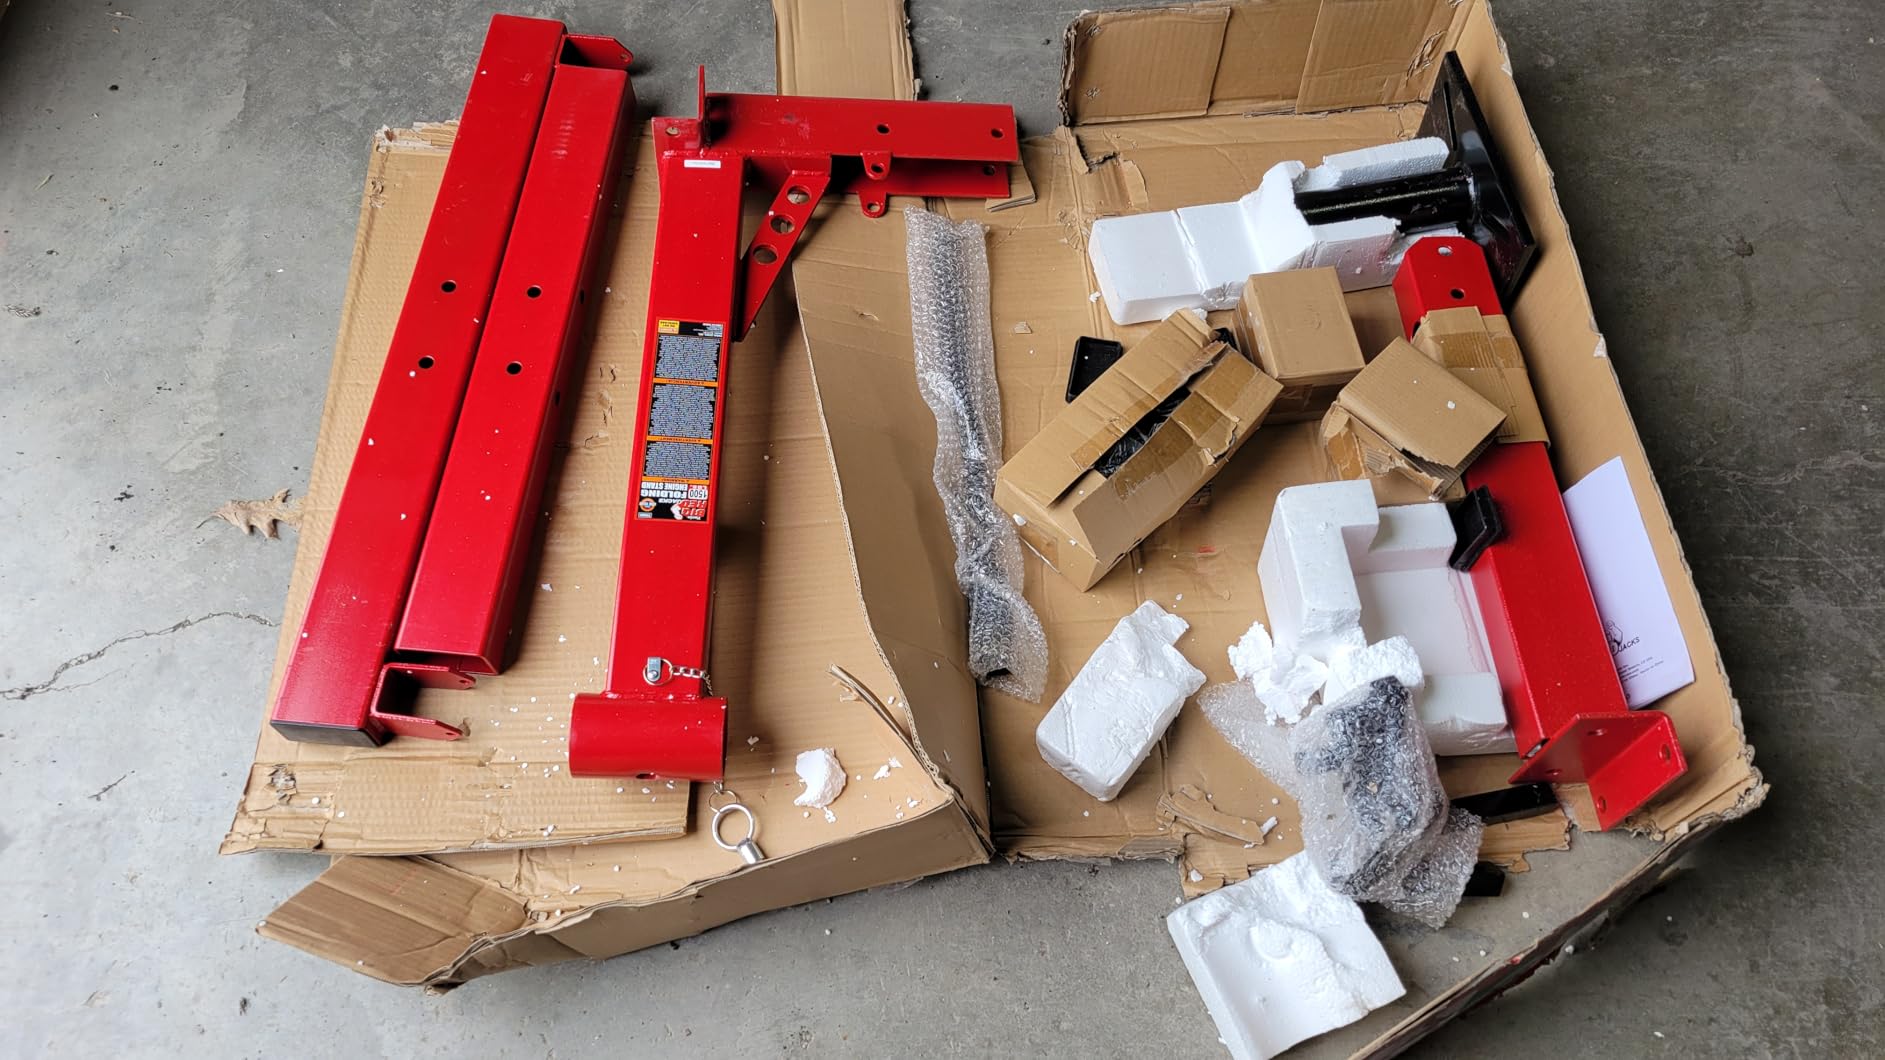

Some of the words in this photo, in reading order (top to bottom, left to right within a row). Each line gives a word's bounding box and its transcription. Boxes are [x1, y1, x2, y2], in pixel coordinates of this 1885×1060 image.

[664, 483, 688, 491] ENGINE
[641, 489, 688, 498] FOLDING
[690, 489, 707, 498] 1500
[1618, 636, 1640, 653] JACKS
